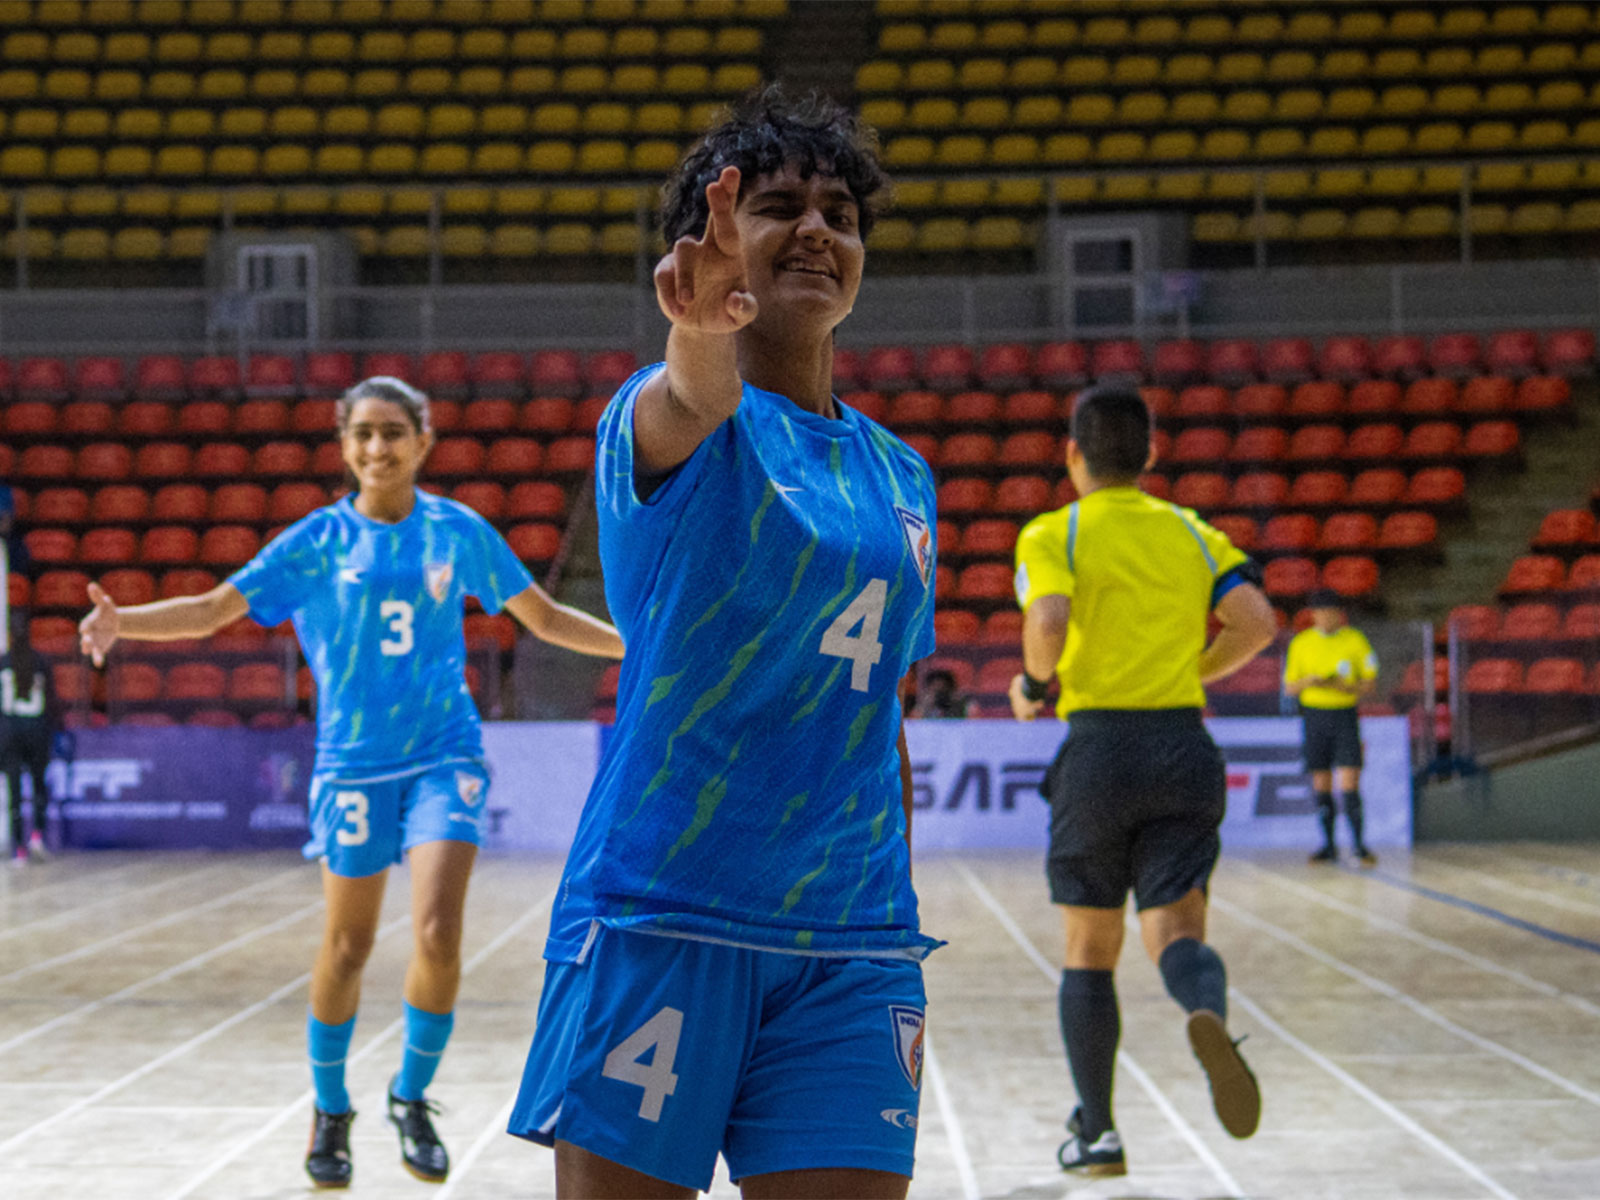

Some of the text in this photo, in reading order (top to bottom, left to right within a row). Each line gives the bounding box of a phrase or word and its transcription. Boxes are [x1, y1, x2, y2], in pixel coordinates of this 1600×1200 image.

[380, 600, 414, 656] 3
[819, 578, 888, 693] 4
[335, 791, 369, 845] 3
[601, 1006, 684, 1123] 4
